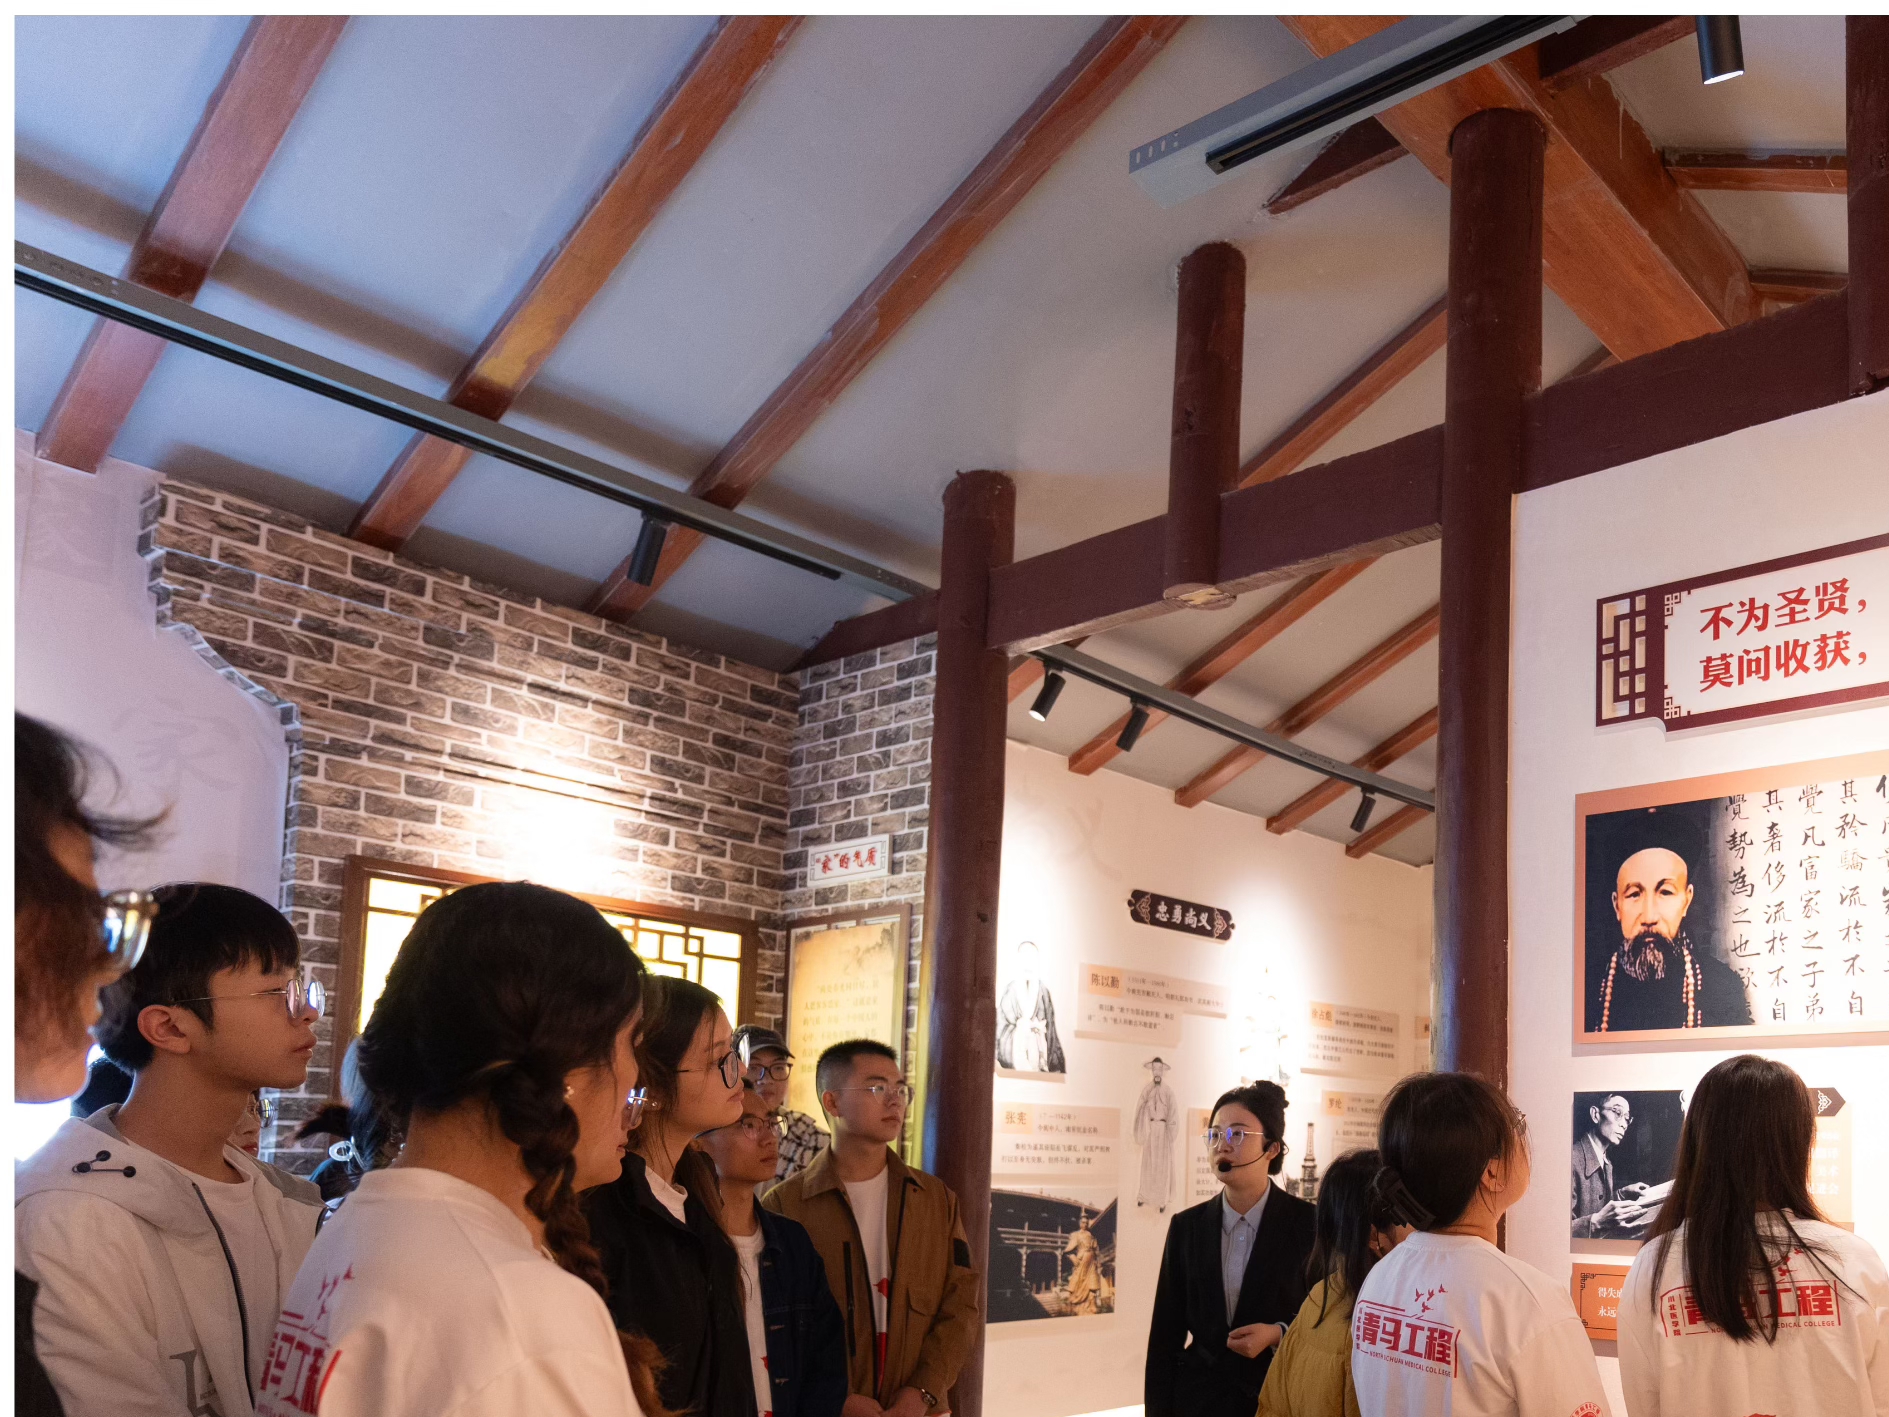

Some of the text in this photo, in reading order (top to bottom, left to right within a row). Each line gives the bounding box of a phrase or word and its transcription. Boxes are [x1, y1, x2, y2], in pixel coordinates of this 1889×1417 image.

[1155, 901, 1212, 931] 忠勇尚义
[1091, 973, 1120, 989] 陈以勤
[1804, 1320, 1836, 1328] COLLEGE
[1362, 1311, 1454, 1366] 青马工程
